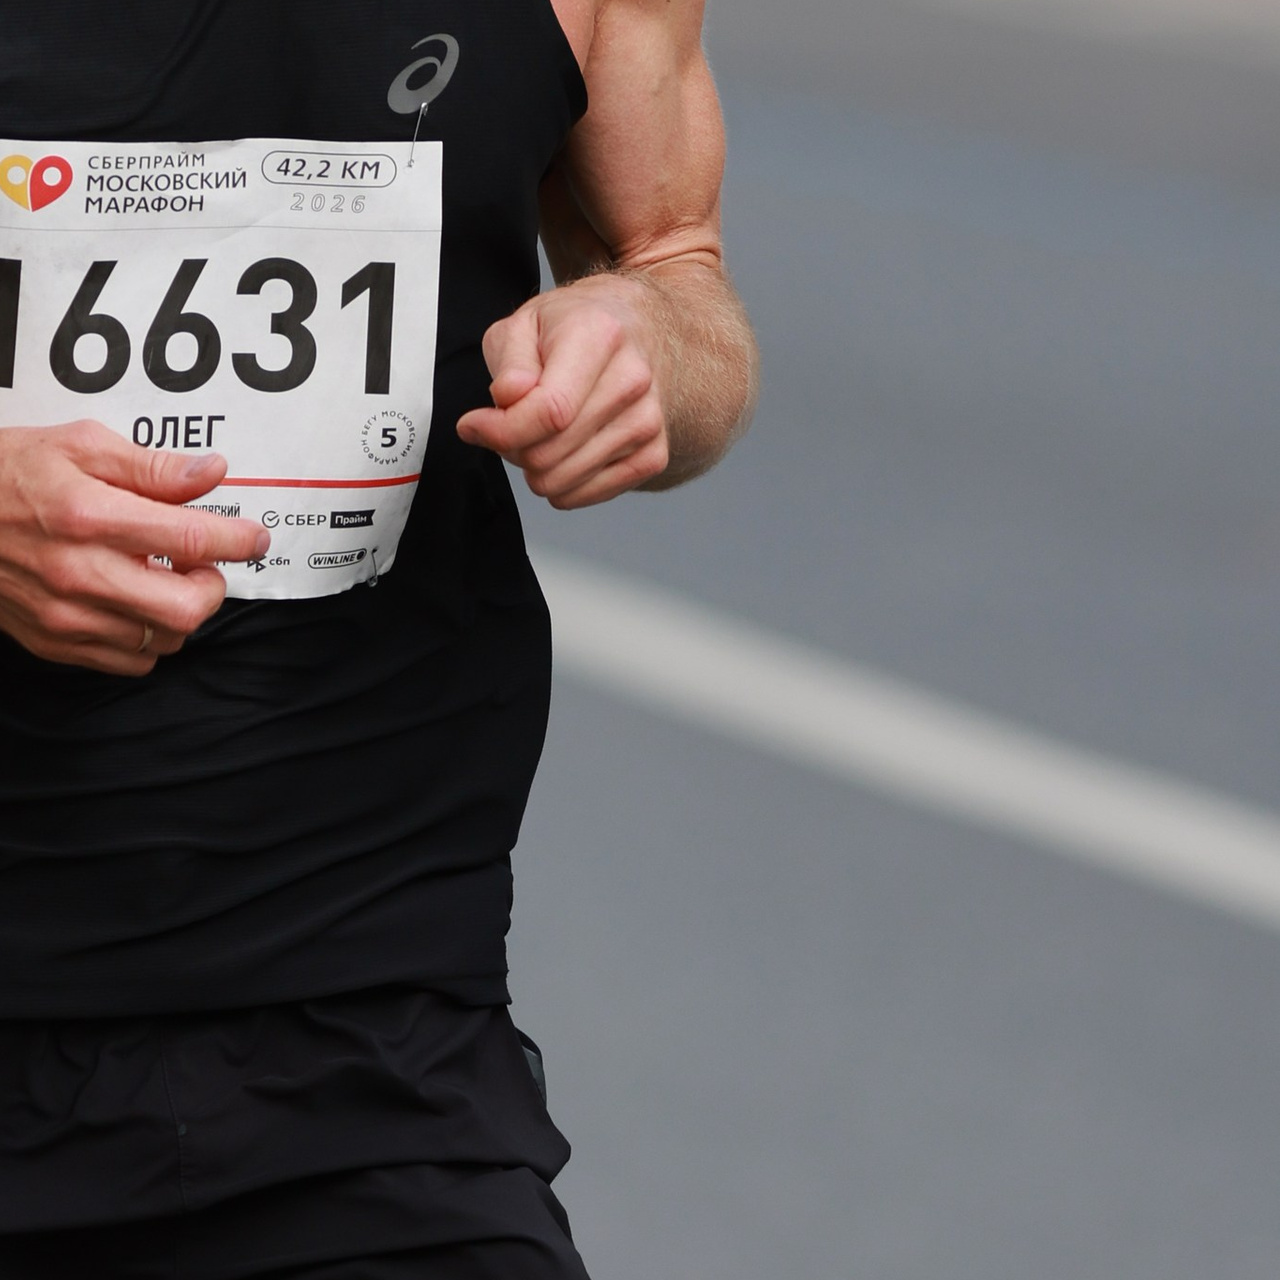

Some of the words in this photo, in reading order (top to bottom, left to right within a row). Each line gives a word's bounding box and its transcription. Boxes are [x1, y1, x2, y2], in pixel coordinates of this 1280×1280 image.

[87, 151, 206, 170] СБЕРПРАЙМ
[276, 158, 331, 181] 42,2
[86, 167, 248, 192] МОСКОВСКИЙ
[85, 195, 205, 214] МАРАФОН
[290, 192, 366, 214] 2026
[132, 415, 225, 448] ОЛЕГ
[380, 427, 397, 448] 5
[361, 439, 399, 465] МАРАФОН
[284, 514, 327, 526] СБЕР
[335, 514, 367, 526] Прайм
[269, 557, 290, 566] сбп
[313, 553, 356, 566] WINLINE
